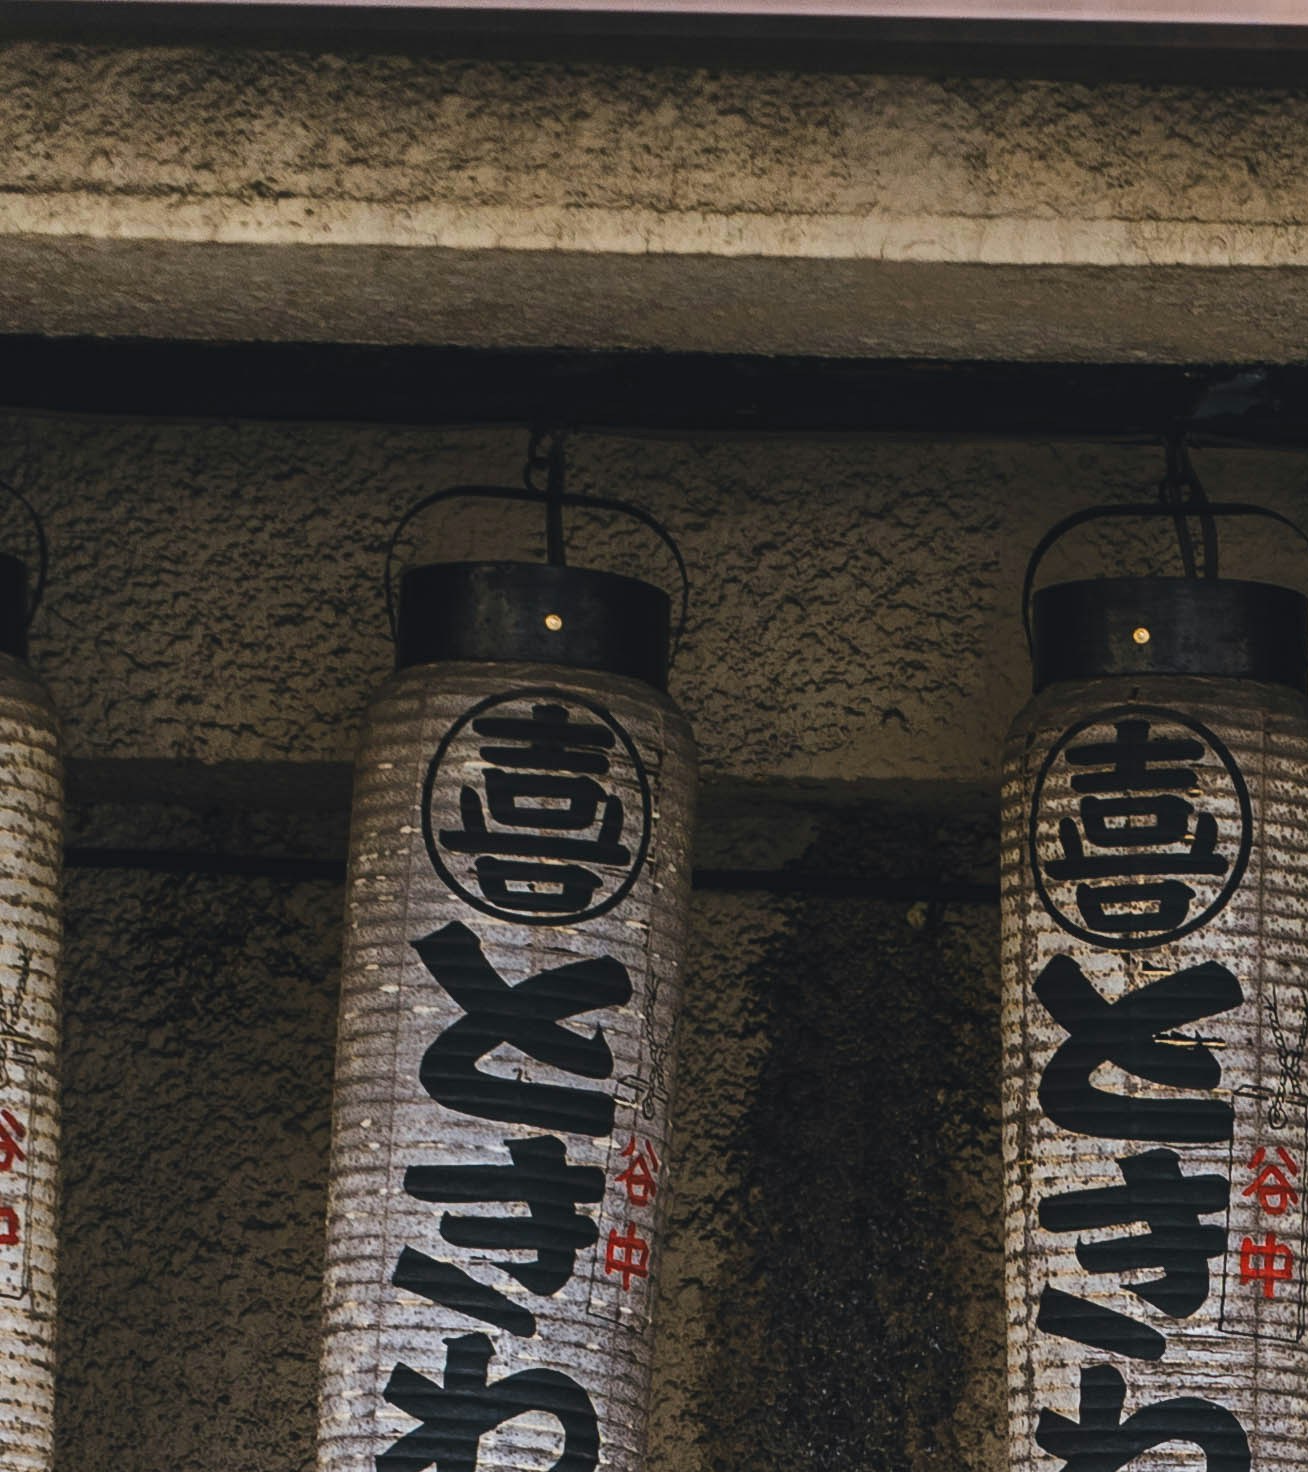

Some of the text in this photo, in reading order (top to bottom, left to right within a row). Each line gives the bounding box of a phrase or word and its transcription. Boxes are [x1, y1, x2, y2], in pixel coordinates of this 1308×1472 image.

[439, 703, 630, 910] 喜
[1045, 720, 1227, 935] 喜
[605, 1136, 658, 1290] 谷中
[1239, 1145, 1299, 1299] 谷中
